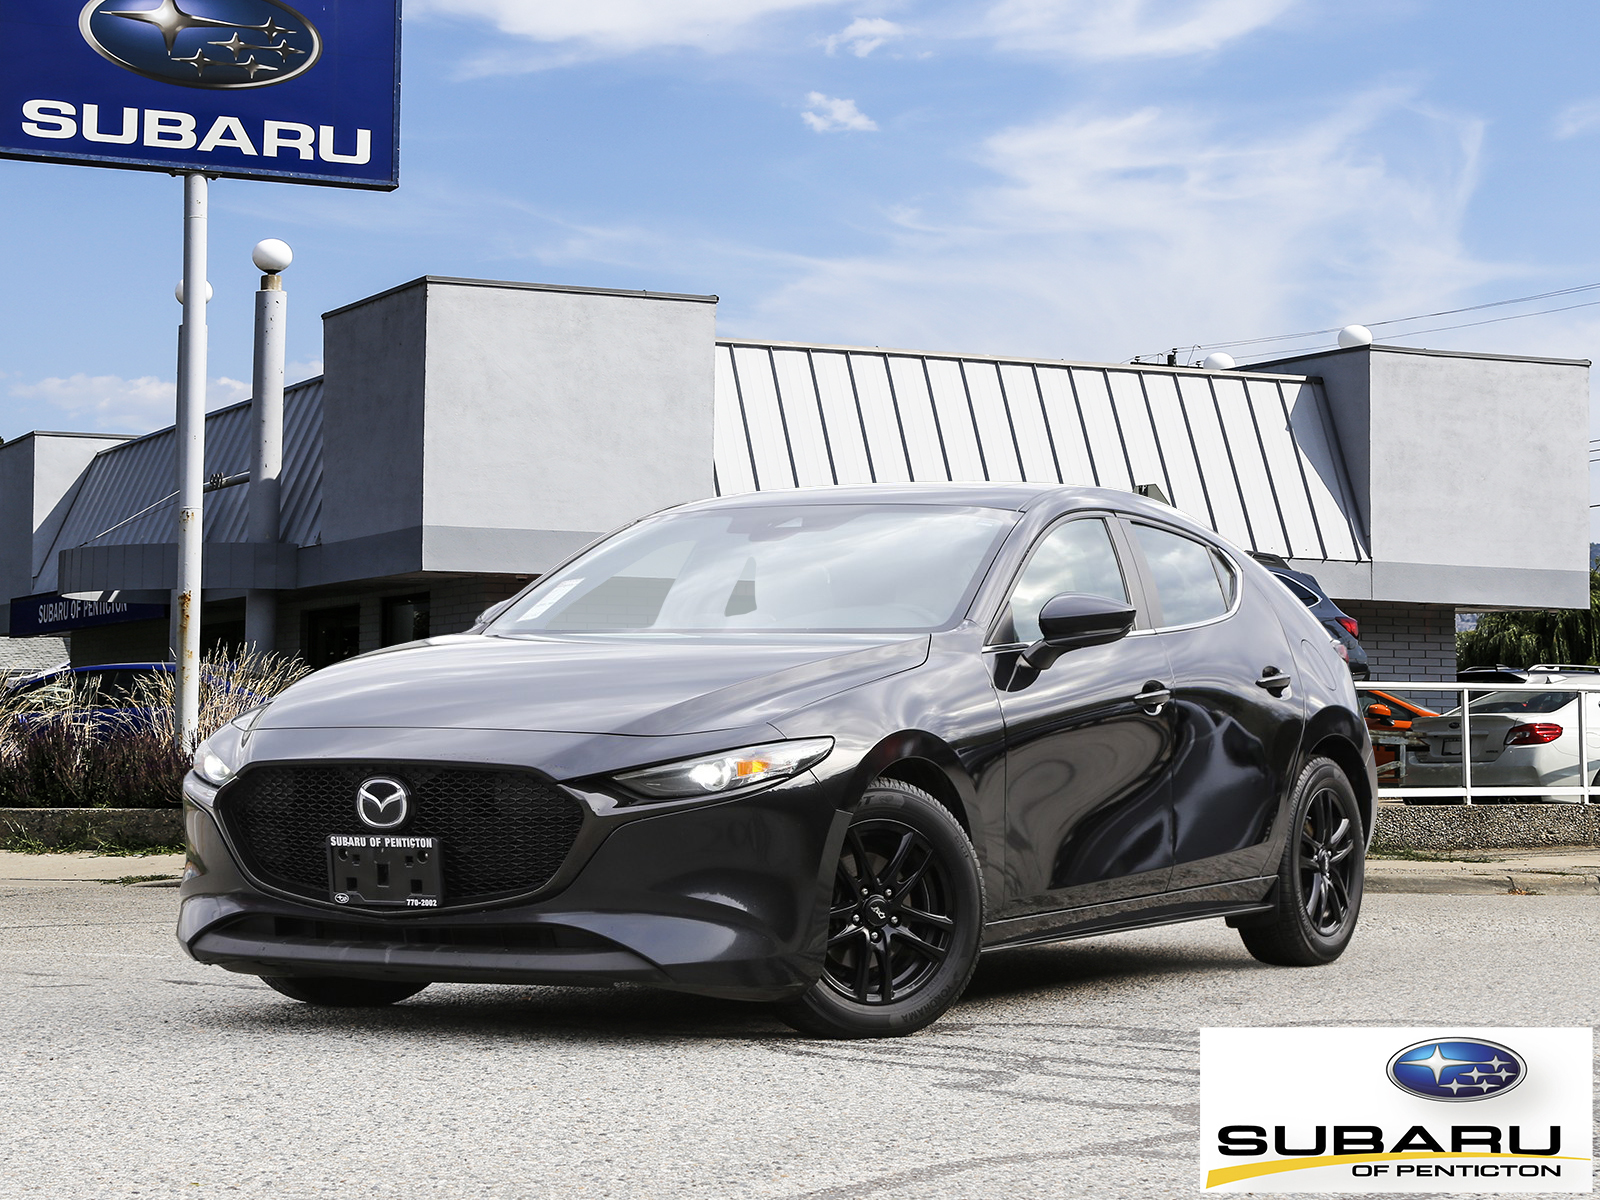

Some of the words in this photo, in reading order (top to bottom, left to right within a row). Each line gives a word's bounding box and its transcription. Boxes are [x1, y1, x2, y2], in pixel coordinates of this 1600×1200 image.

[21, 99, 372, 165] SUBARU
[38, 602, 69, 624] SUBARU
[70, 600, 82, 618] OF
[330, 836, 367, 847] SUBARU
[369, 837, 381, 847] OF
[385, 838, 433, 848] PENTICTON
[406, 899, 437, 907] 770-2002
